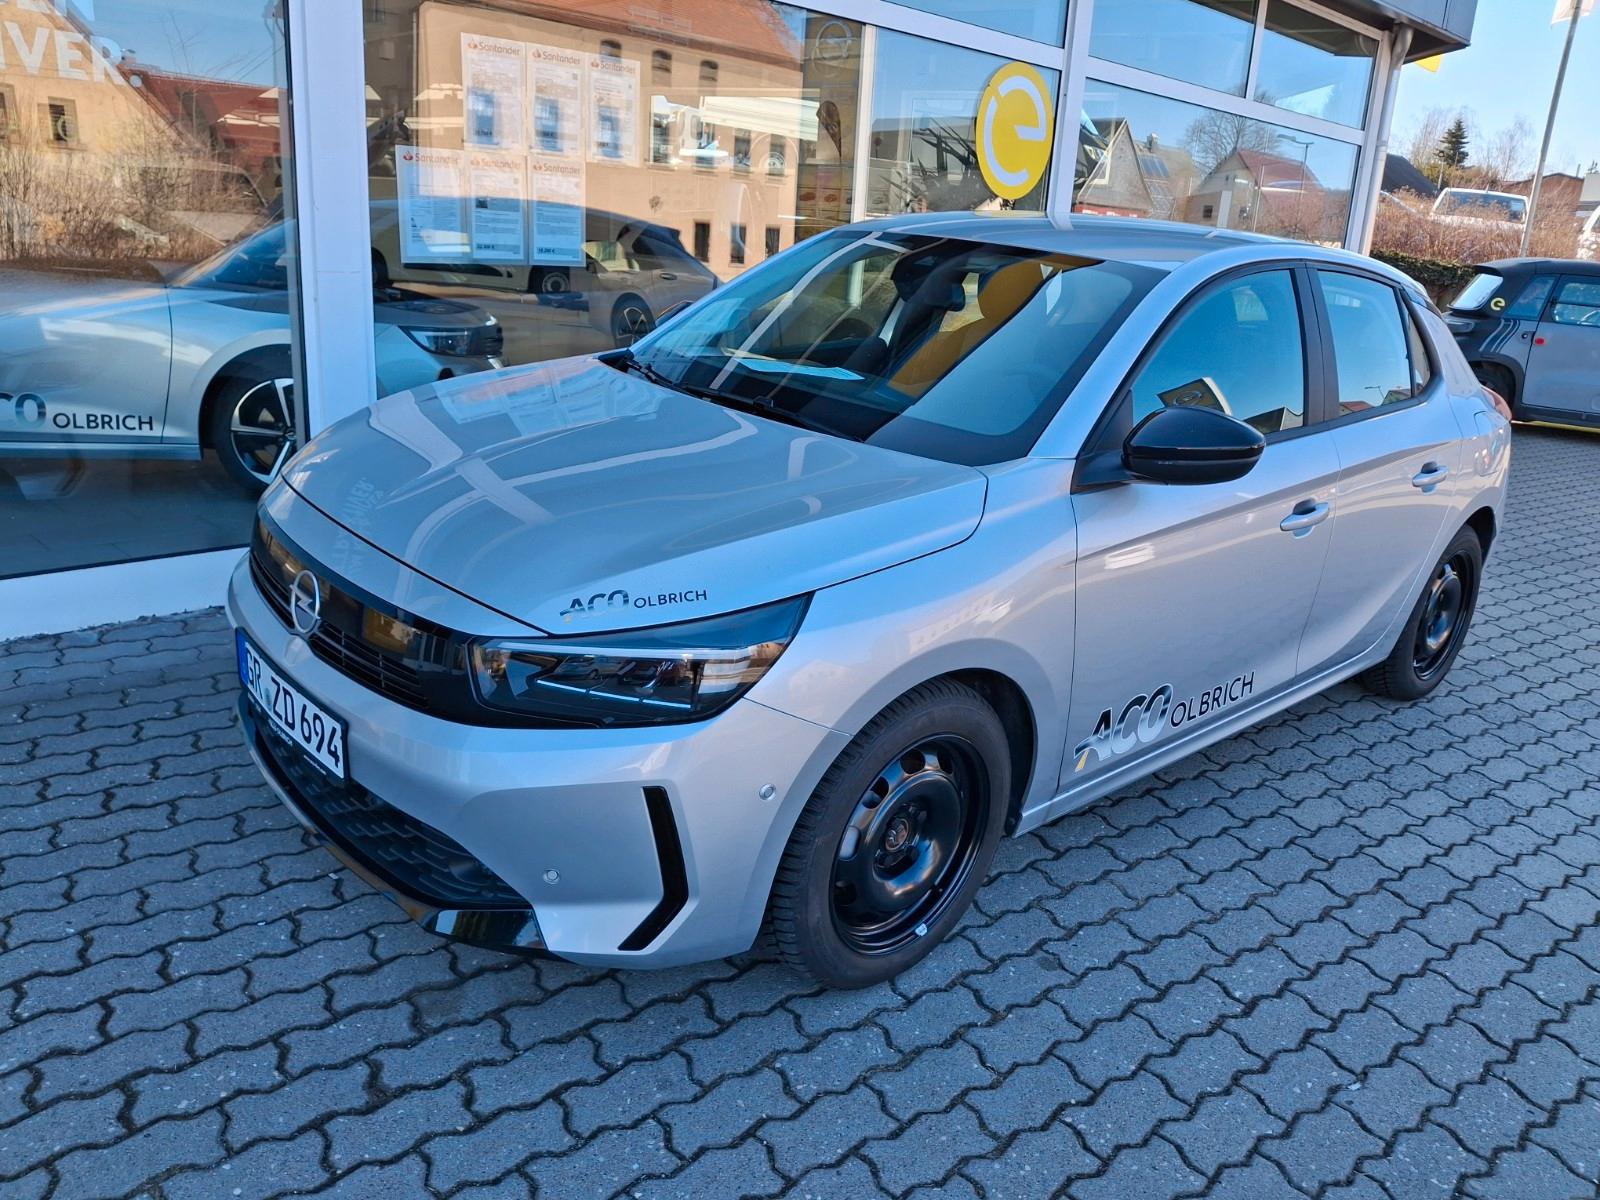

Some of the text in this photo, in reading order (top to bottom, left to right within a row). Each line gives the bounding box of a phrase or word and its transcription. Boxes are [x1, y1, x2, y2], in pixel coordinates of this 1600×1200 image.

[478, 41, 520, 56] Santander
[542, 51, 581, 66] Santander
[599, 60, 636, 75] Santander
[543, 163, 580, 175] Santander
[52, 412, 154, 431] OLBRICH
[560, 589, 708, 619] ACO OLBRICH
[271, 674, 296, 732] ZD
[300, 703, 341, 769] 694
[1073, 671, 1255, 762] ACO OLBRICH
